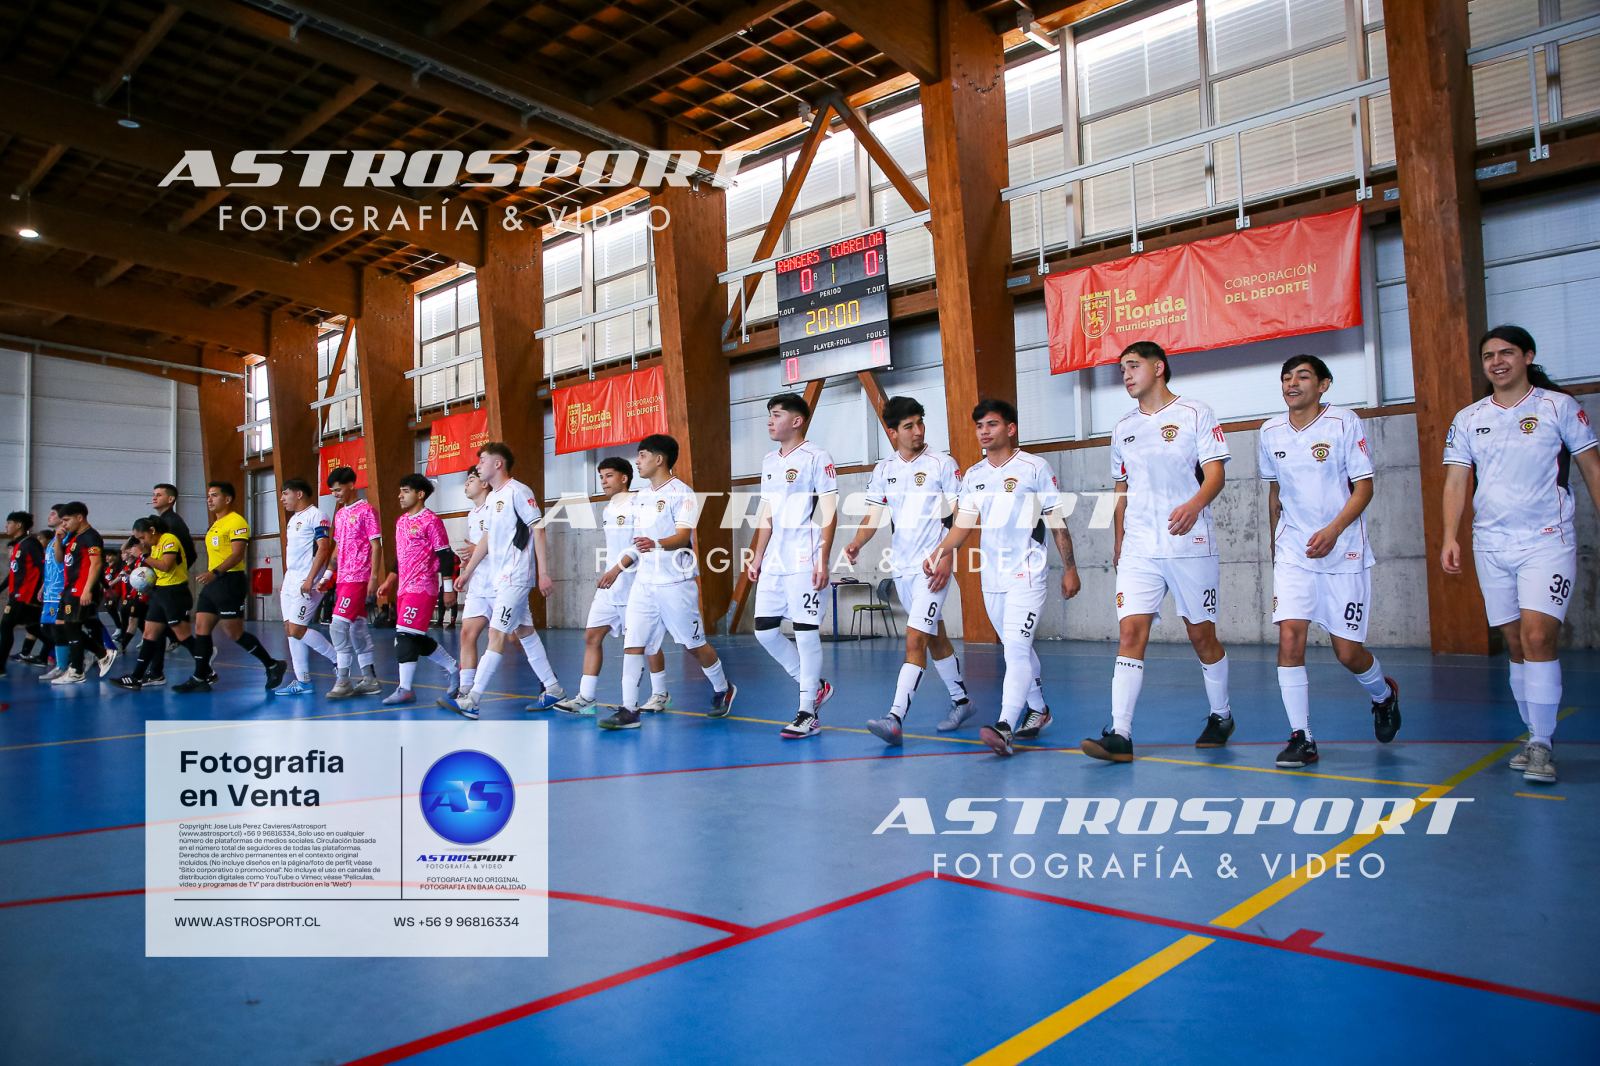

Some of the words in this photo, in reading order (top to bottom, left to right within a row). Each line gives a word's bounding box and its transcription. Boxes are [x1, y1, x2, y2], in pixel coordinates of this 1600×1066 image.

[777, 250, 820, 273] RANGERS
[829, 231, 883, 258] COBRELOA
[801, 268, 814, 293] 0
[864, 250, 878, 276] 0
[1224, 263, 1317, 289] CORPORACIÓN
[779, 308, 795, 316] T.OUT
[820, 287, 841, 298] PERIOD
[866, 284, 885, 295] T.OUT
[1114, 288, 1136, 304] La
[1225, 292, 1248, 304] DEL
[1251, 280, 1309, 300] DEPORTE
[805, 300, 860, 335] 20:00
[1114, 296, 1186, 322] Florida
[1116, 312, 1187, 333] municipalidad
[782, 348, 800, 358] FOULS
[813, 338, 851, 351] PLAYER-FOUL
[866, 330, 886, 339] FOULS
[582, 402, 592, 412] La
[581, 410, 611, 424] Florida
[439, 440, 460, 453] Florida
[1550, 574, 1571, 598] 36
[340, 597, 351, 608] 19
[803, 593, 820, 608] 24
[1203, 588, 1216, 607] 28
[300, 605, 306, 615] 9
[403, 606, 418, 618] 25
[501, 606, 512, 620] 14
[928, 601, 938, 617] 6
[1344, 602, 1364, 622] 65
[693, 621, 698, 635] 7
[1024, 612, 1036, 630] 5
